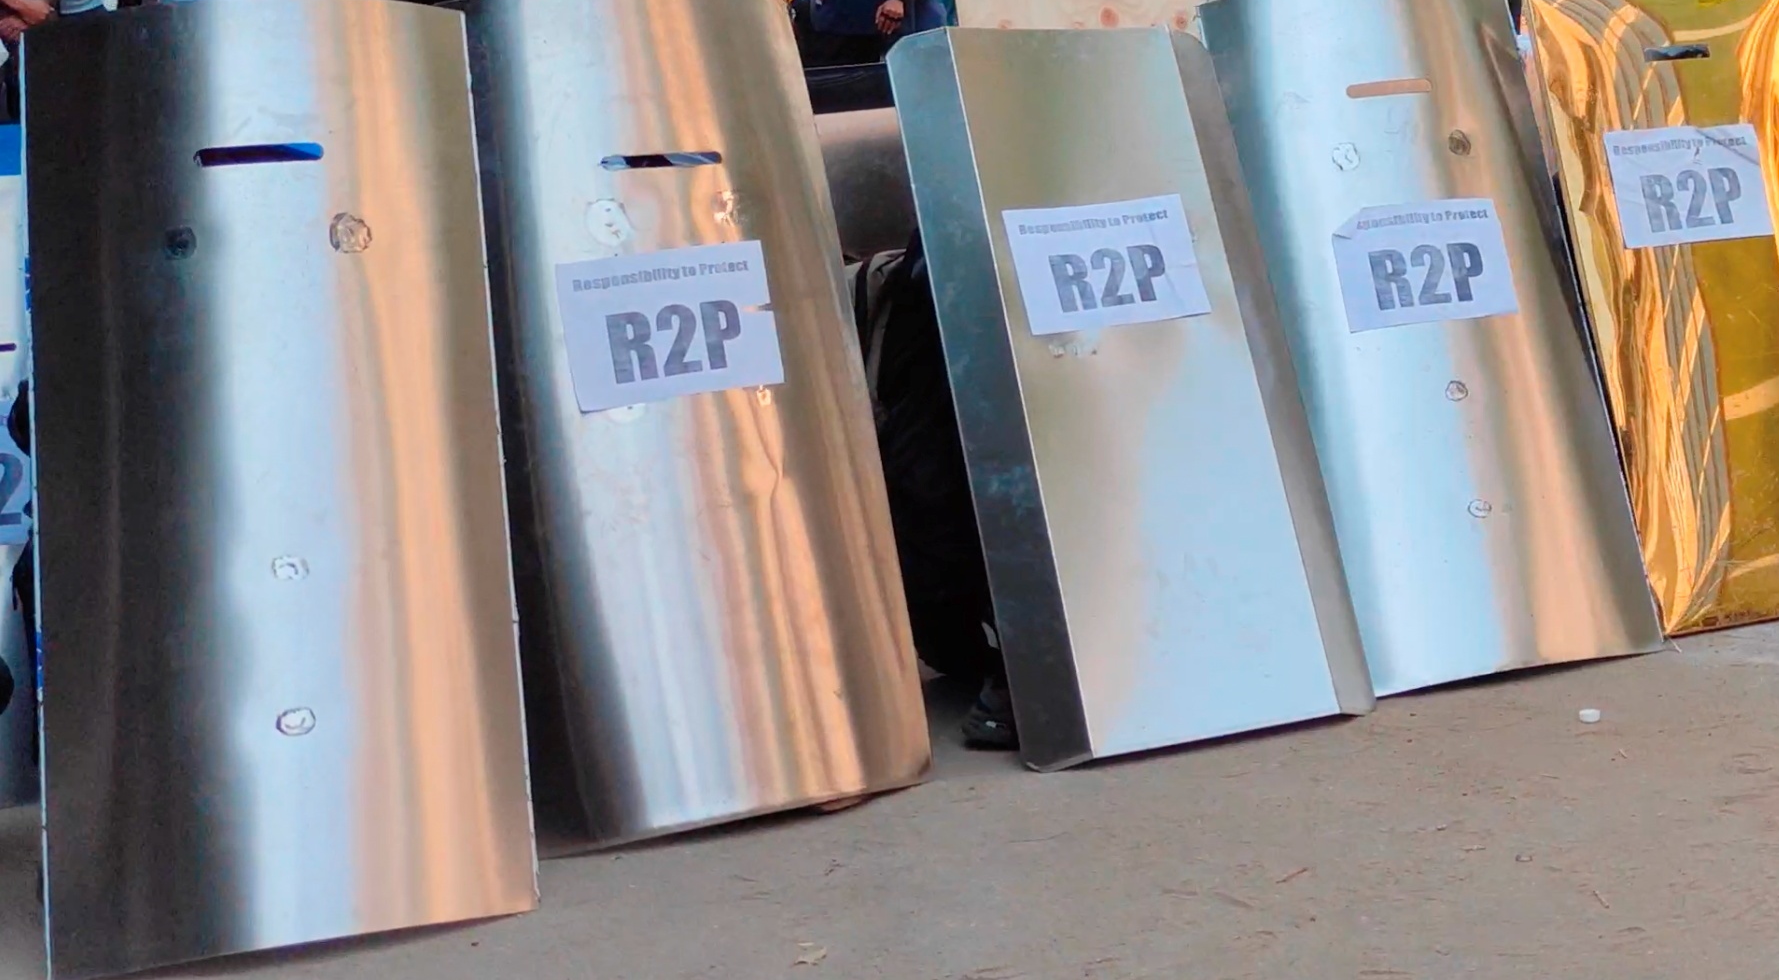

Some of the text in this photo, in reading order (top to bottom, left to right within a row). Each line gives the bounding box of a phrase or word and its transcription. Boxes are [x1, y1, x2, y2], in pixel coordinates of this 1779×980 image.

[1108, 216, 1121, 227] to
[1122, 209, 1168, 226] Protect
[1444, 208, 1489, 221] Protect
[1639, 167, 1742, 233] R2P
[572, 259, 750, 293] Responsibility to Protect
[1048, 244, 1166, 313] R2P
[1368, 242, 1483, 311] R2P
[605, 299, 741, 385] R2P
